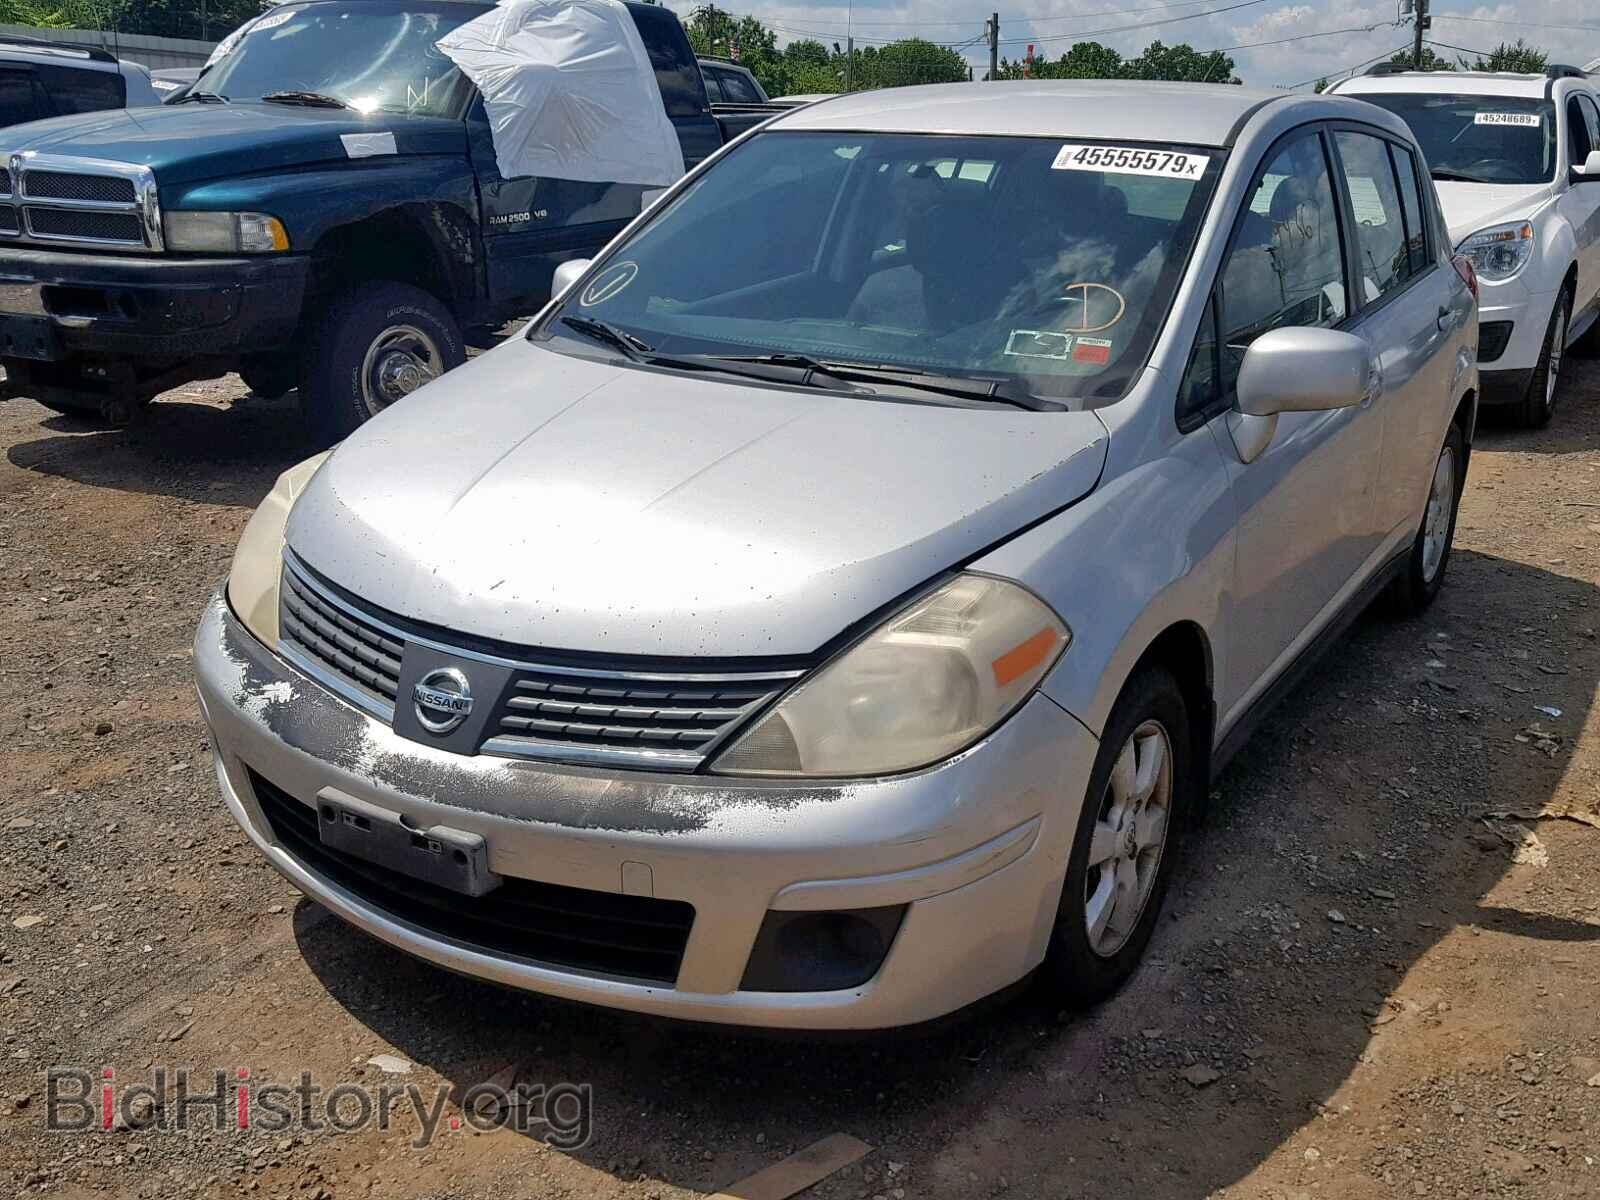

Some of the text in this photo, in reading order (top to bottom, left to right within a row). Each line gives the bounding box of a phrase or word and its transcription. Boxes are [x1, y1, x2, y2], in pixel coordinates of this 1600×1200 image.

[488, 215, 508, 225] RAM
[508, 211, 531, 223] 2500
[414, 687, 464, 711] NISSAN
